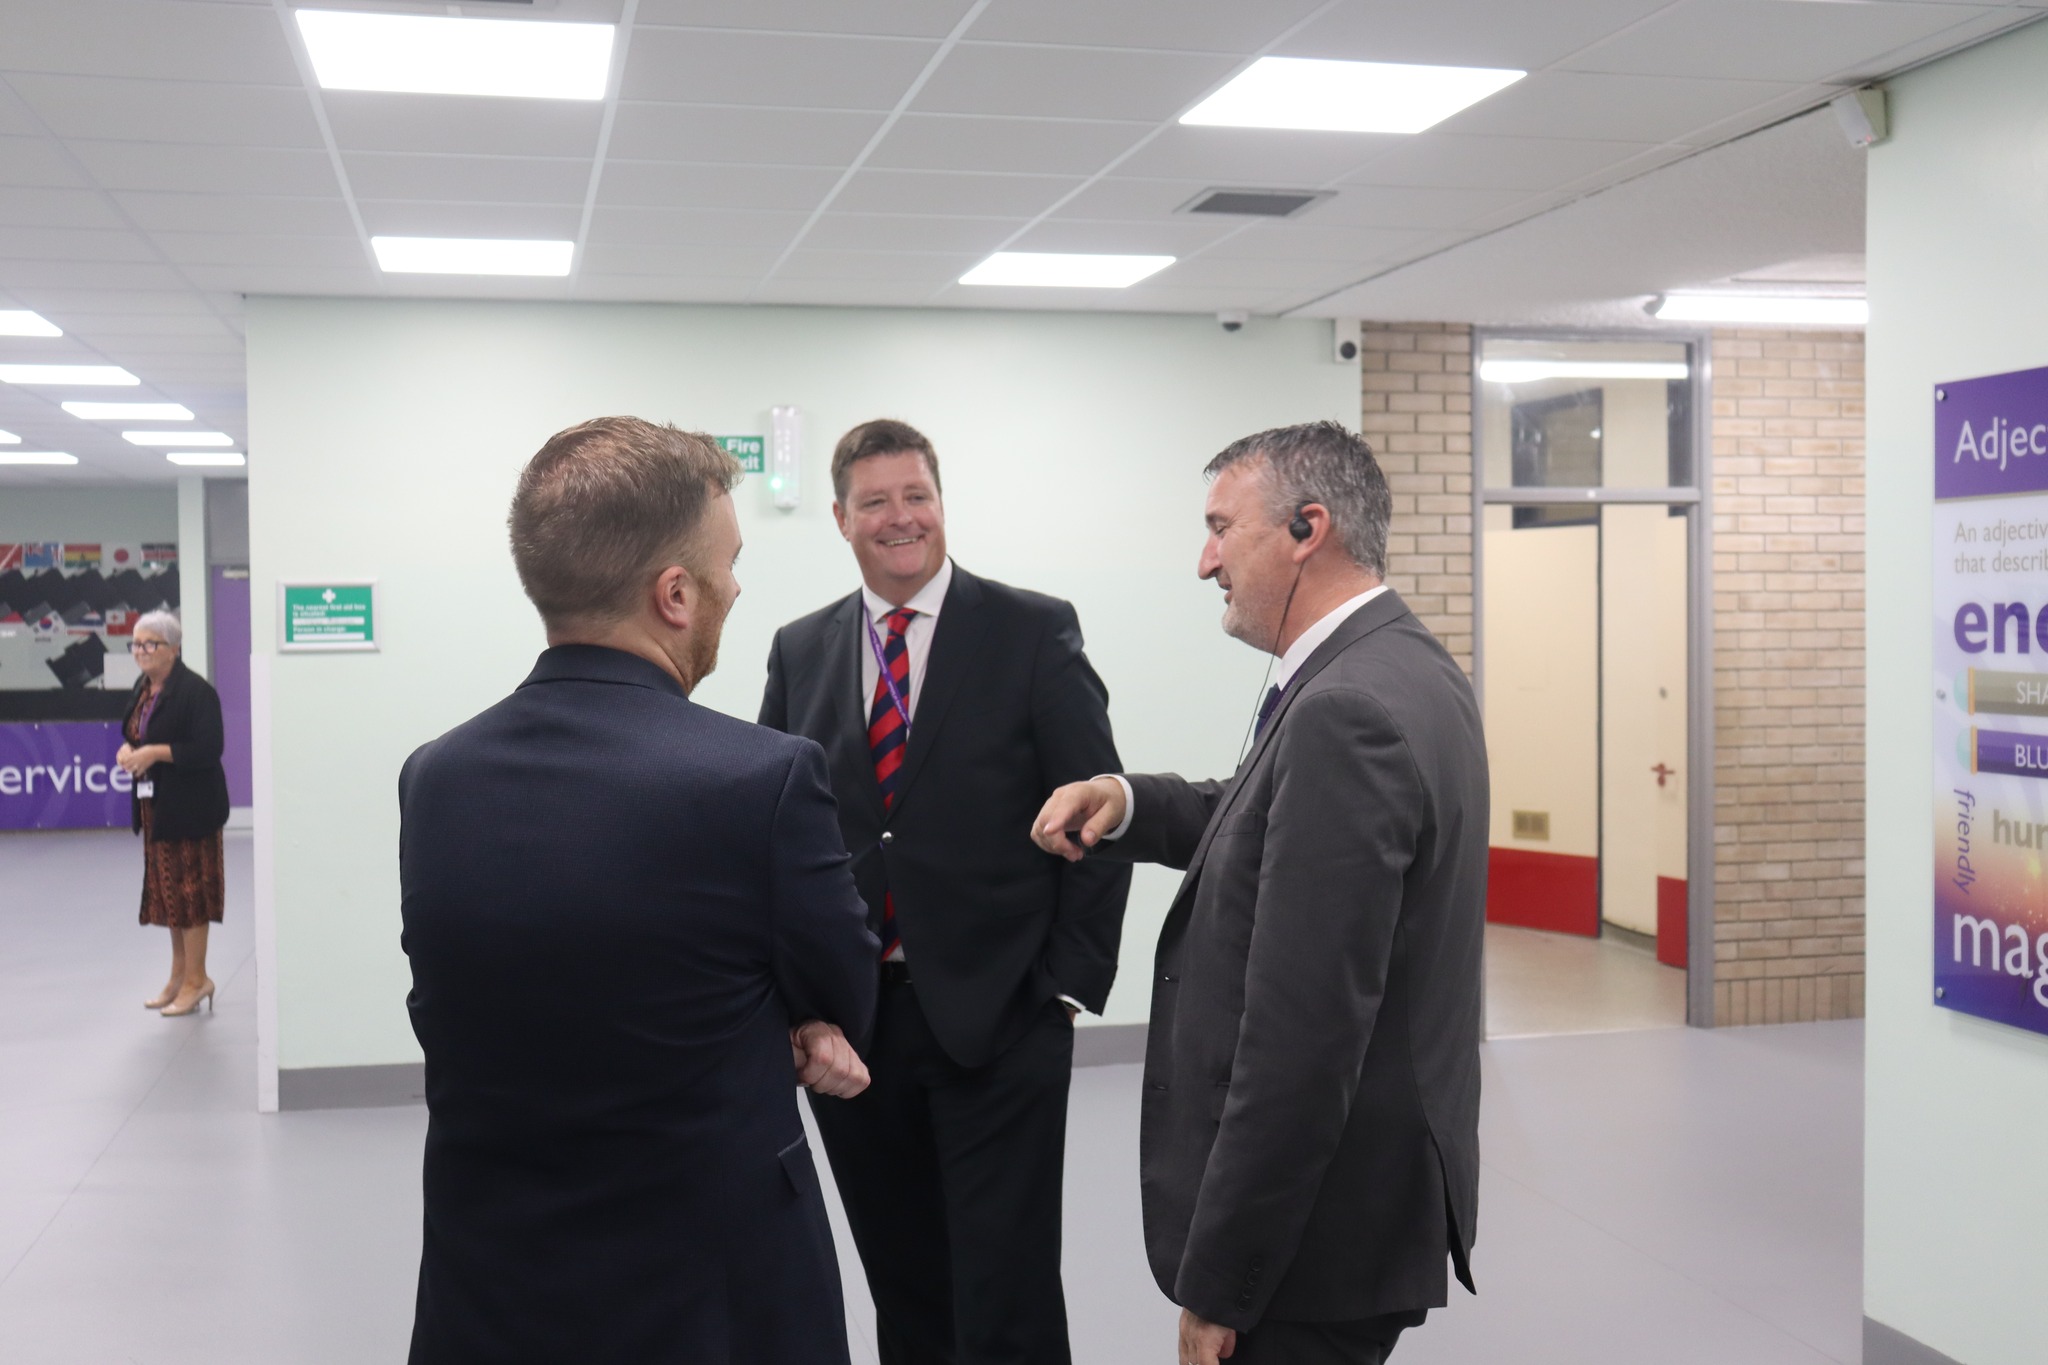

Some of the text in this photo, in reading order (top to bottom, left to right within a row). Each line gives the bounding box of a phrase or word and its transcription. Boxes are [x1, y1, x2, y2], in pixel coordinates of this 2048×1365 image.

[726, 438, 760, 454] Fire
[1954, 416, 2048, 472] Adjec
[1954, 521, 1977, 543] An
[1954, 552, 1986, 574] that
[0, 755, 133, 795] ervice
[1953, 788, 1976, 895] friendly
